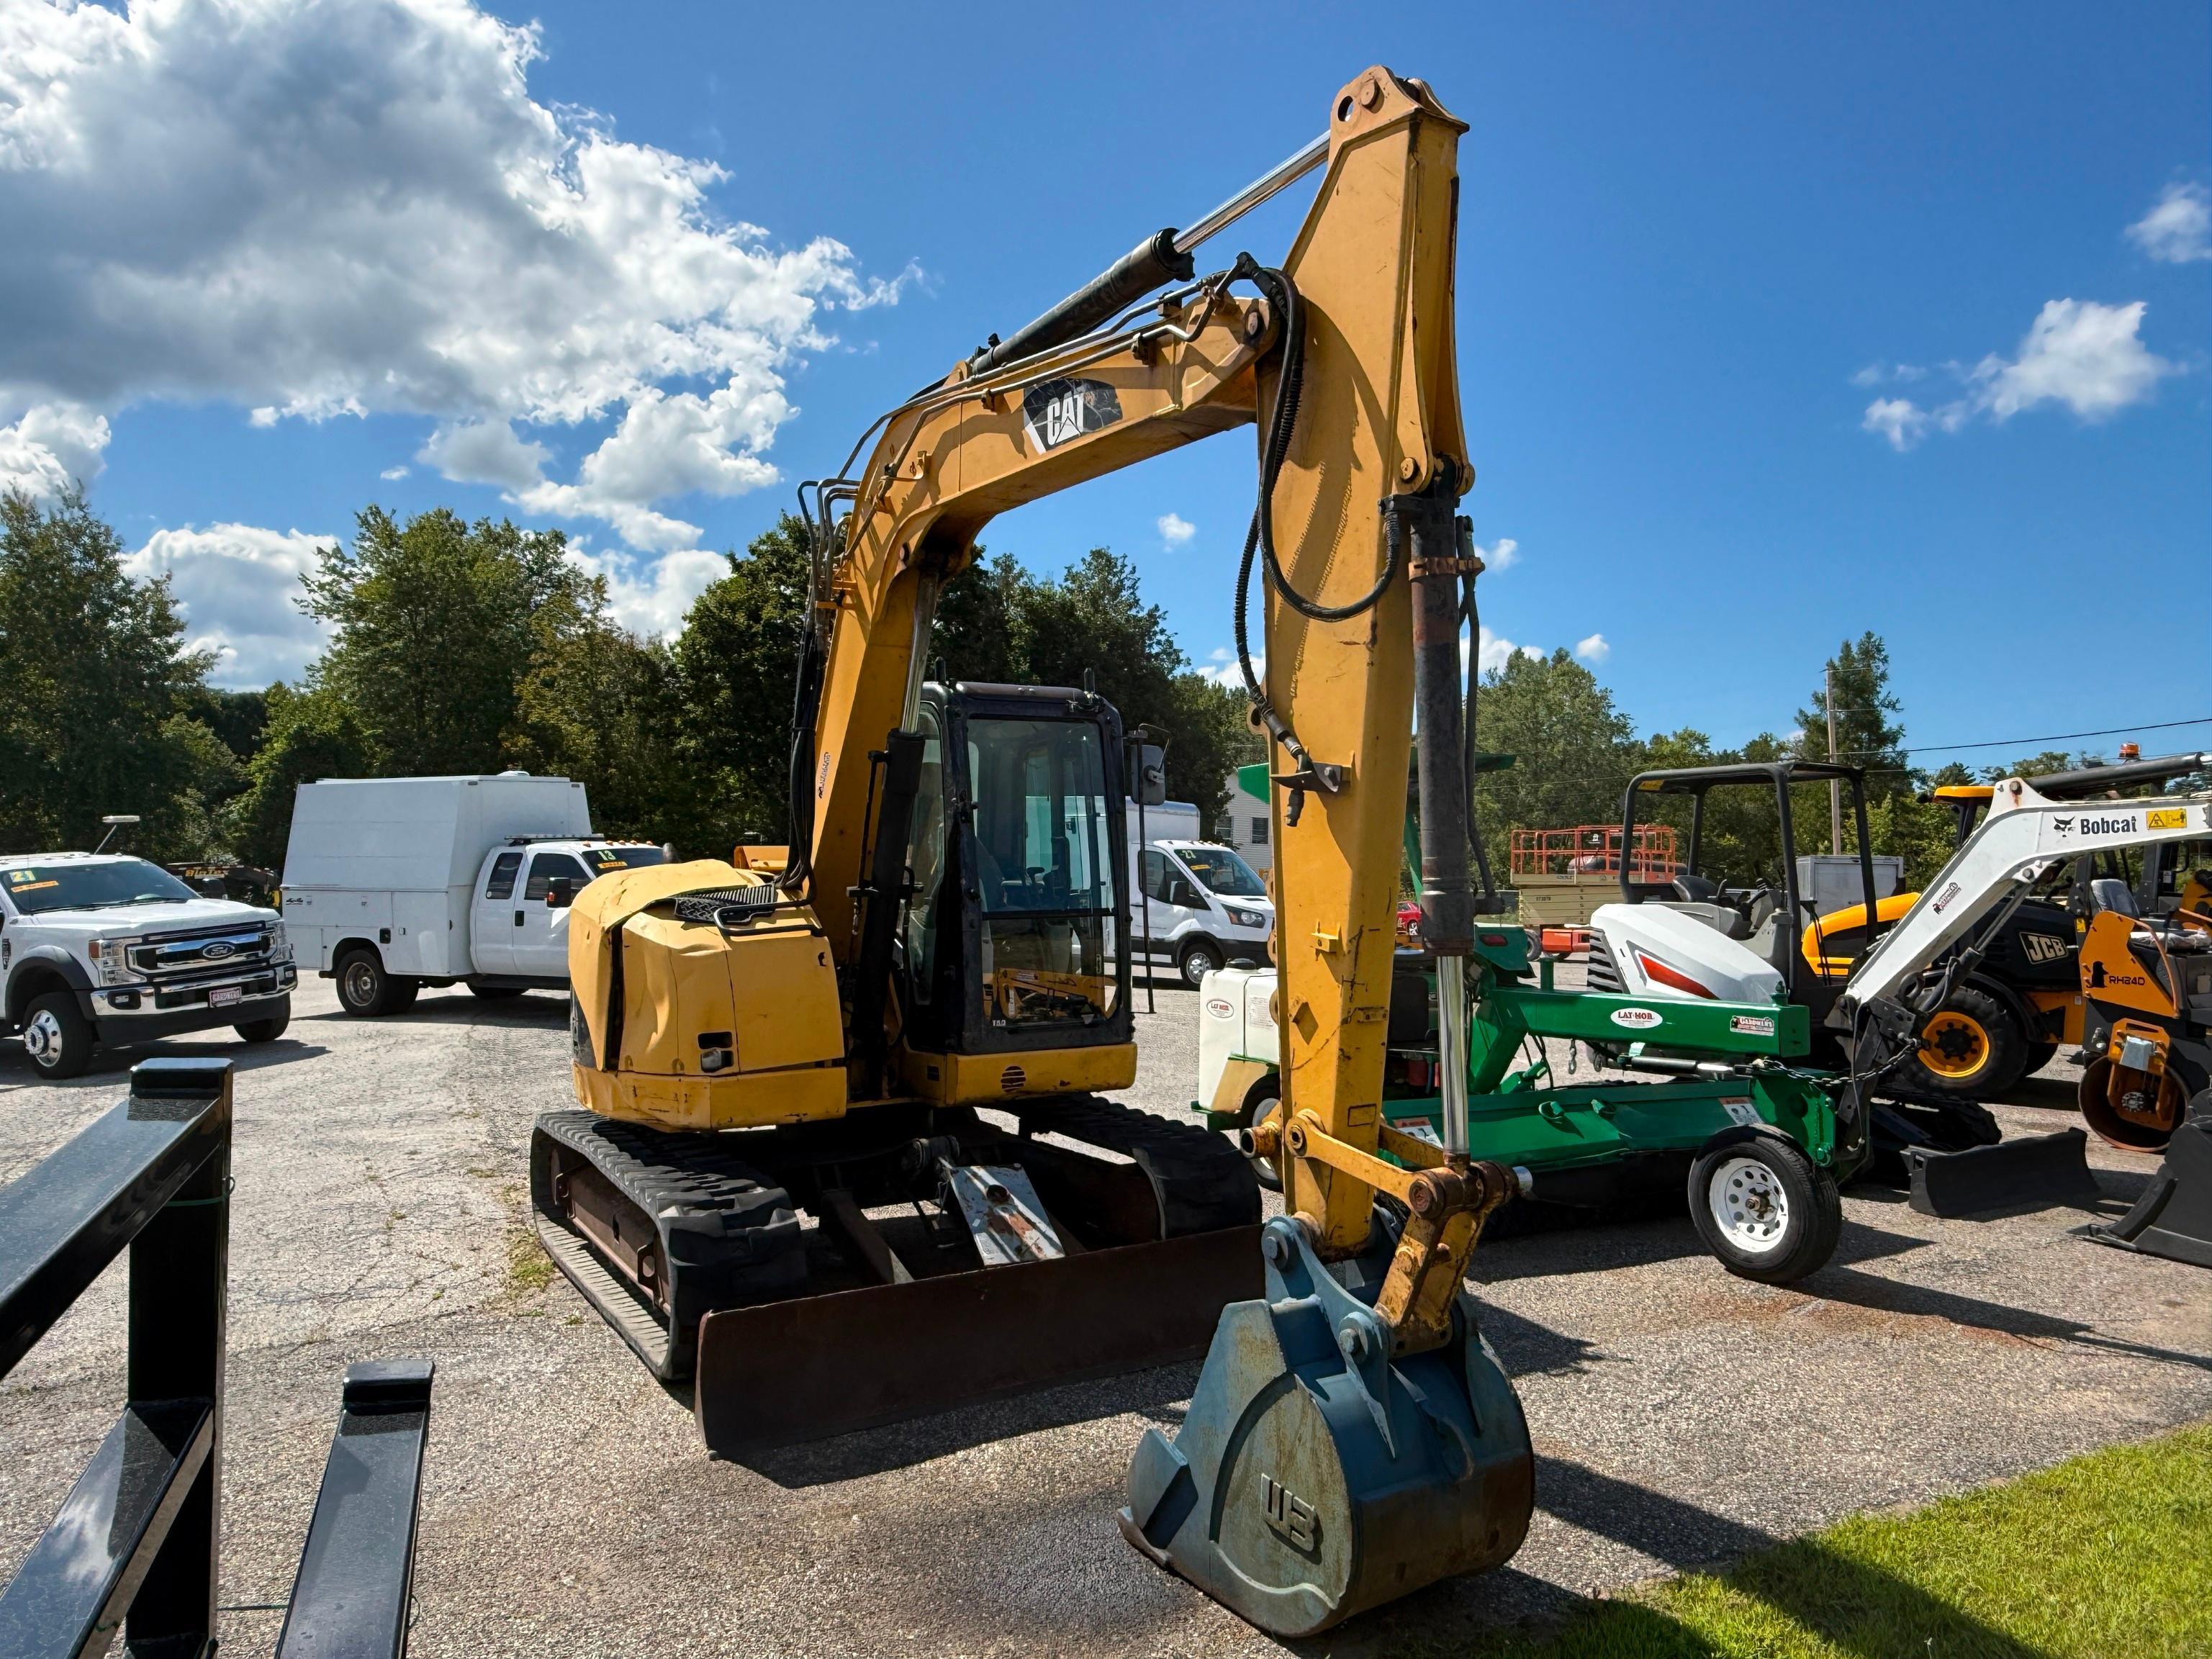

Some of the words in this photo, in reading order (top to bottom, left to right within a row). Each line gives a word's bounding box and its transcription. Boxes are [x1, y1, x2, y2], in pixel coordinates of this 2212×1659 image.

[1047, 391, 1085, 446] CAT
[2080, 815, 2137, 836] Bobcat
[597, 850, 617, 861] 13
[2027, 936, 2066, 962] JCB
